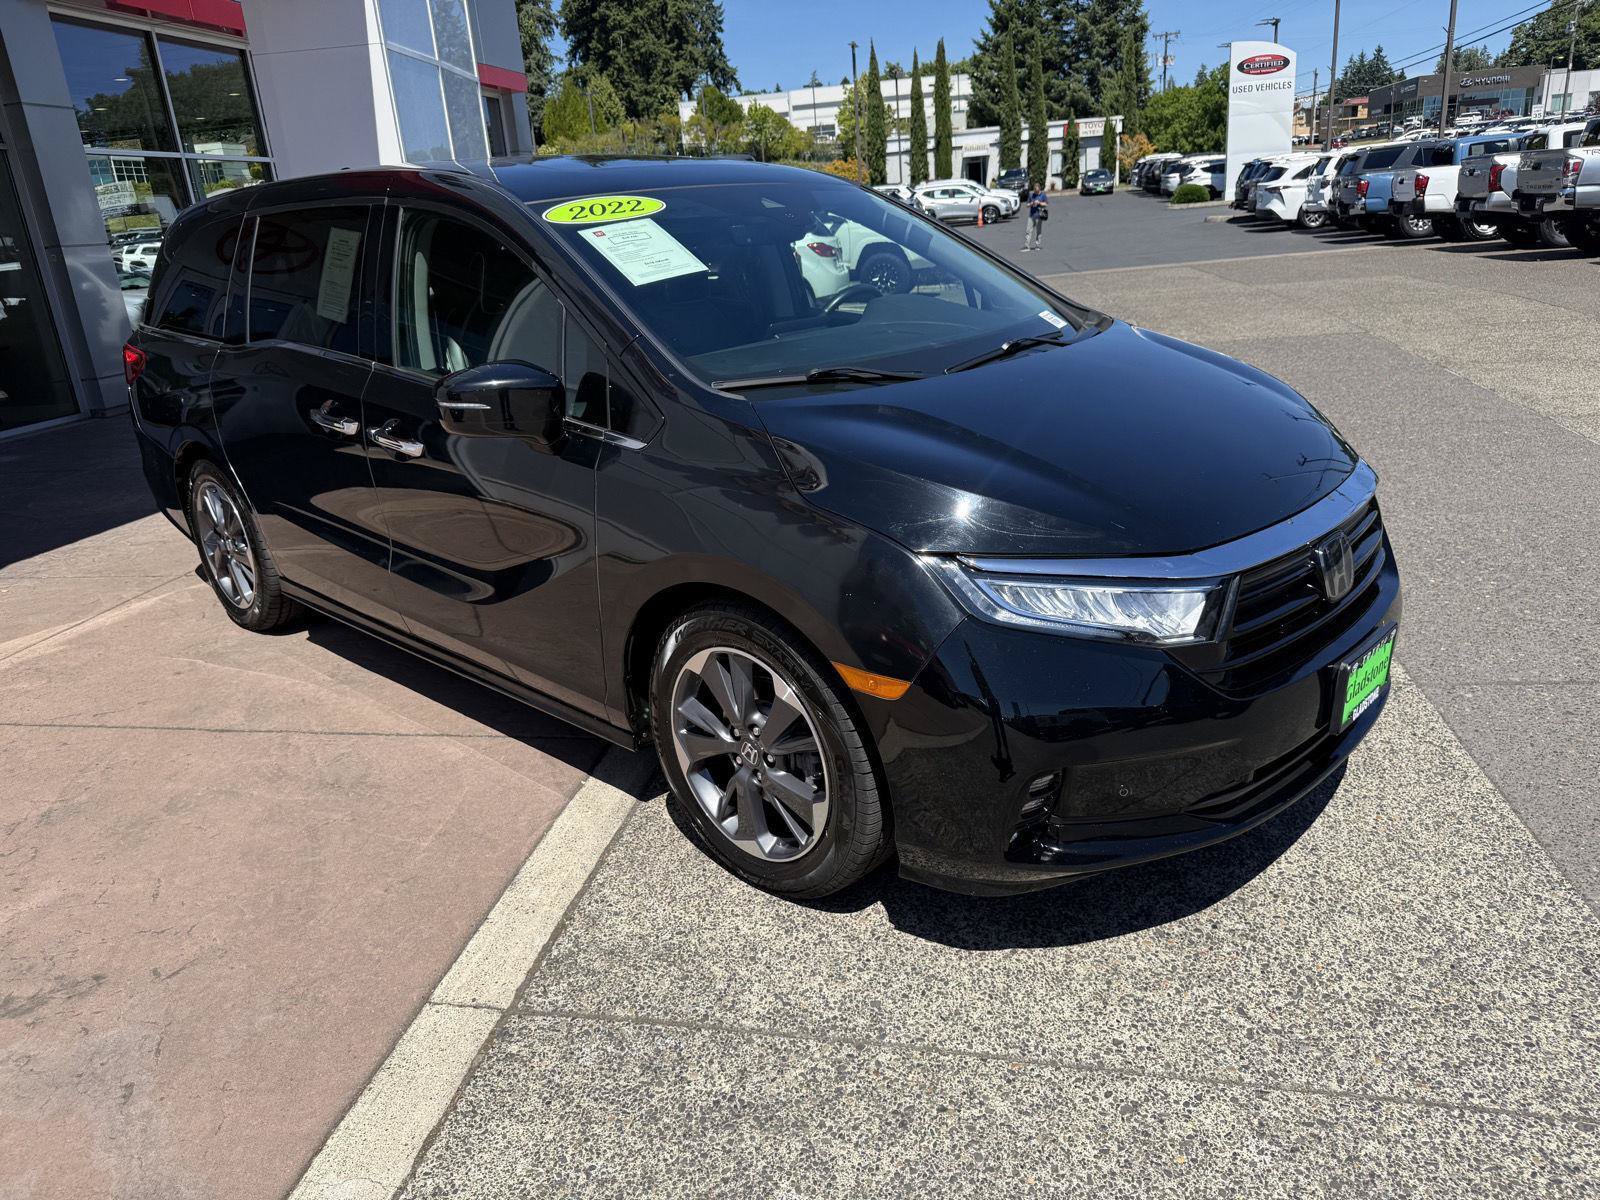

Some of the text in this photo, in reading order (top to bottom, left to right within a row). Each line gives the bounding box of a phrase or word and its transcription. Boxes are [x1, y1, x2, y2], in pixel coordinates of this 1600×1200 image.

[1243, 60, 1284, 69] CERTIFIED
[1475, 75, 1510, 86] HYUNDAI
[1232, 81, 1292, 94] USED VEHICLES
[568, 199, 645, 220] 2022
[1345, 656, 1389, 704] Gladstone
